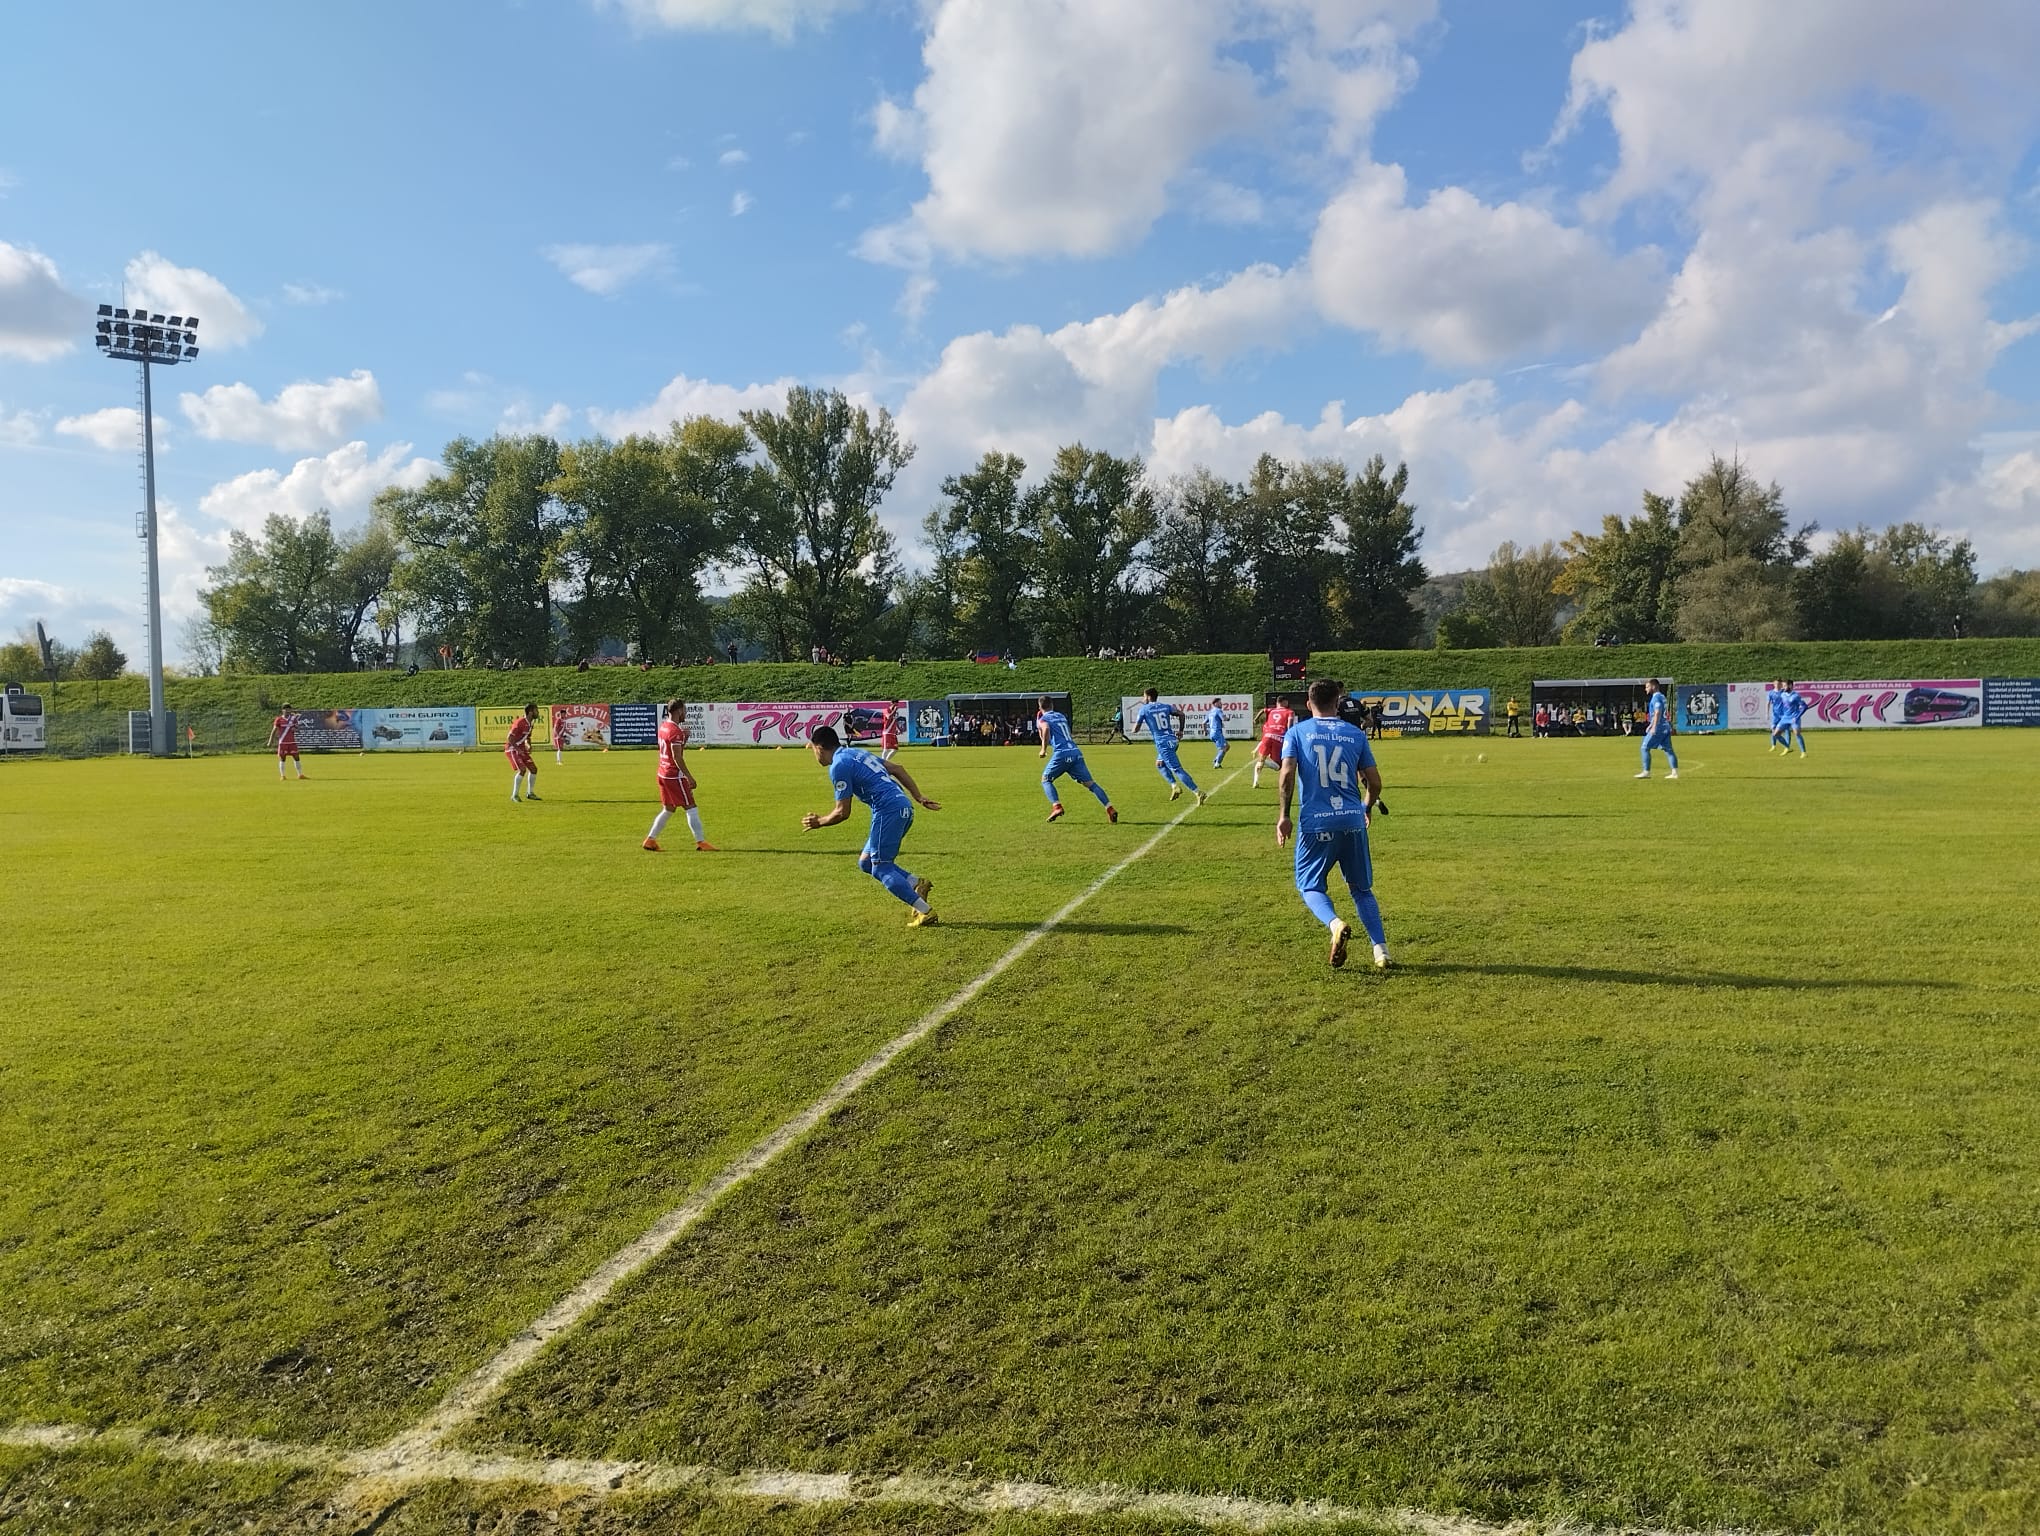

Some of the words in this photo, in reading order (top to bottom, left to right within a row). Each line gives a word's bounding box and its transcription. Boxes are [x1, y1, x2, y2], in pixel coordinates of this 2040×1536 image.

[1223, 702, 1249, 711] 2012
[484, 715, 545, 725] LABRR
[1153, 712, 1169, 730] 16
[1272, 713, 1282, 723] 9
[1057, 722, 1072, 741] 11
[1331, 732, 1355, 743] Lipova
[1313, 744, 1349, 789] 14
